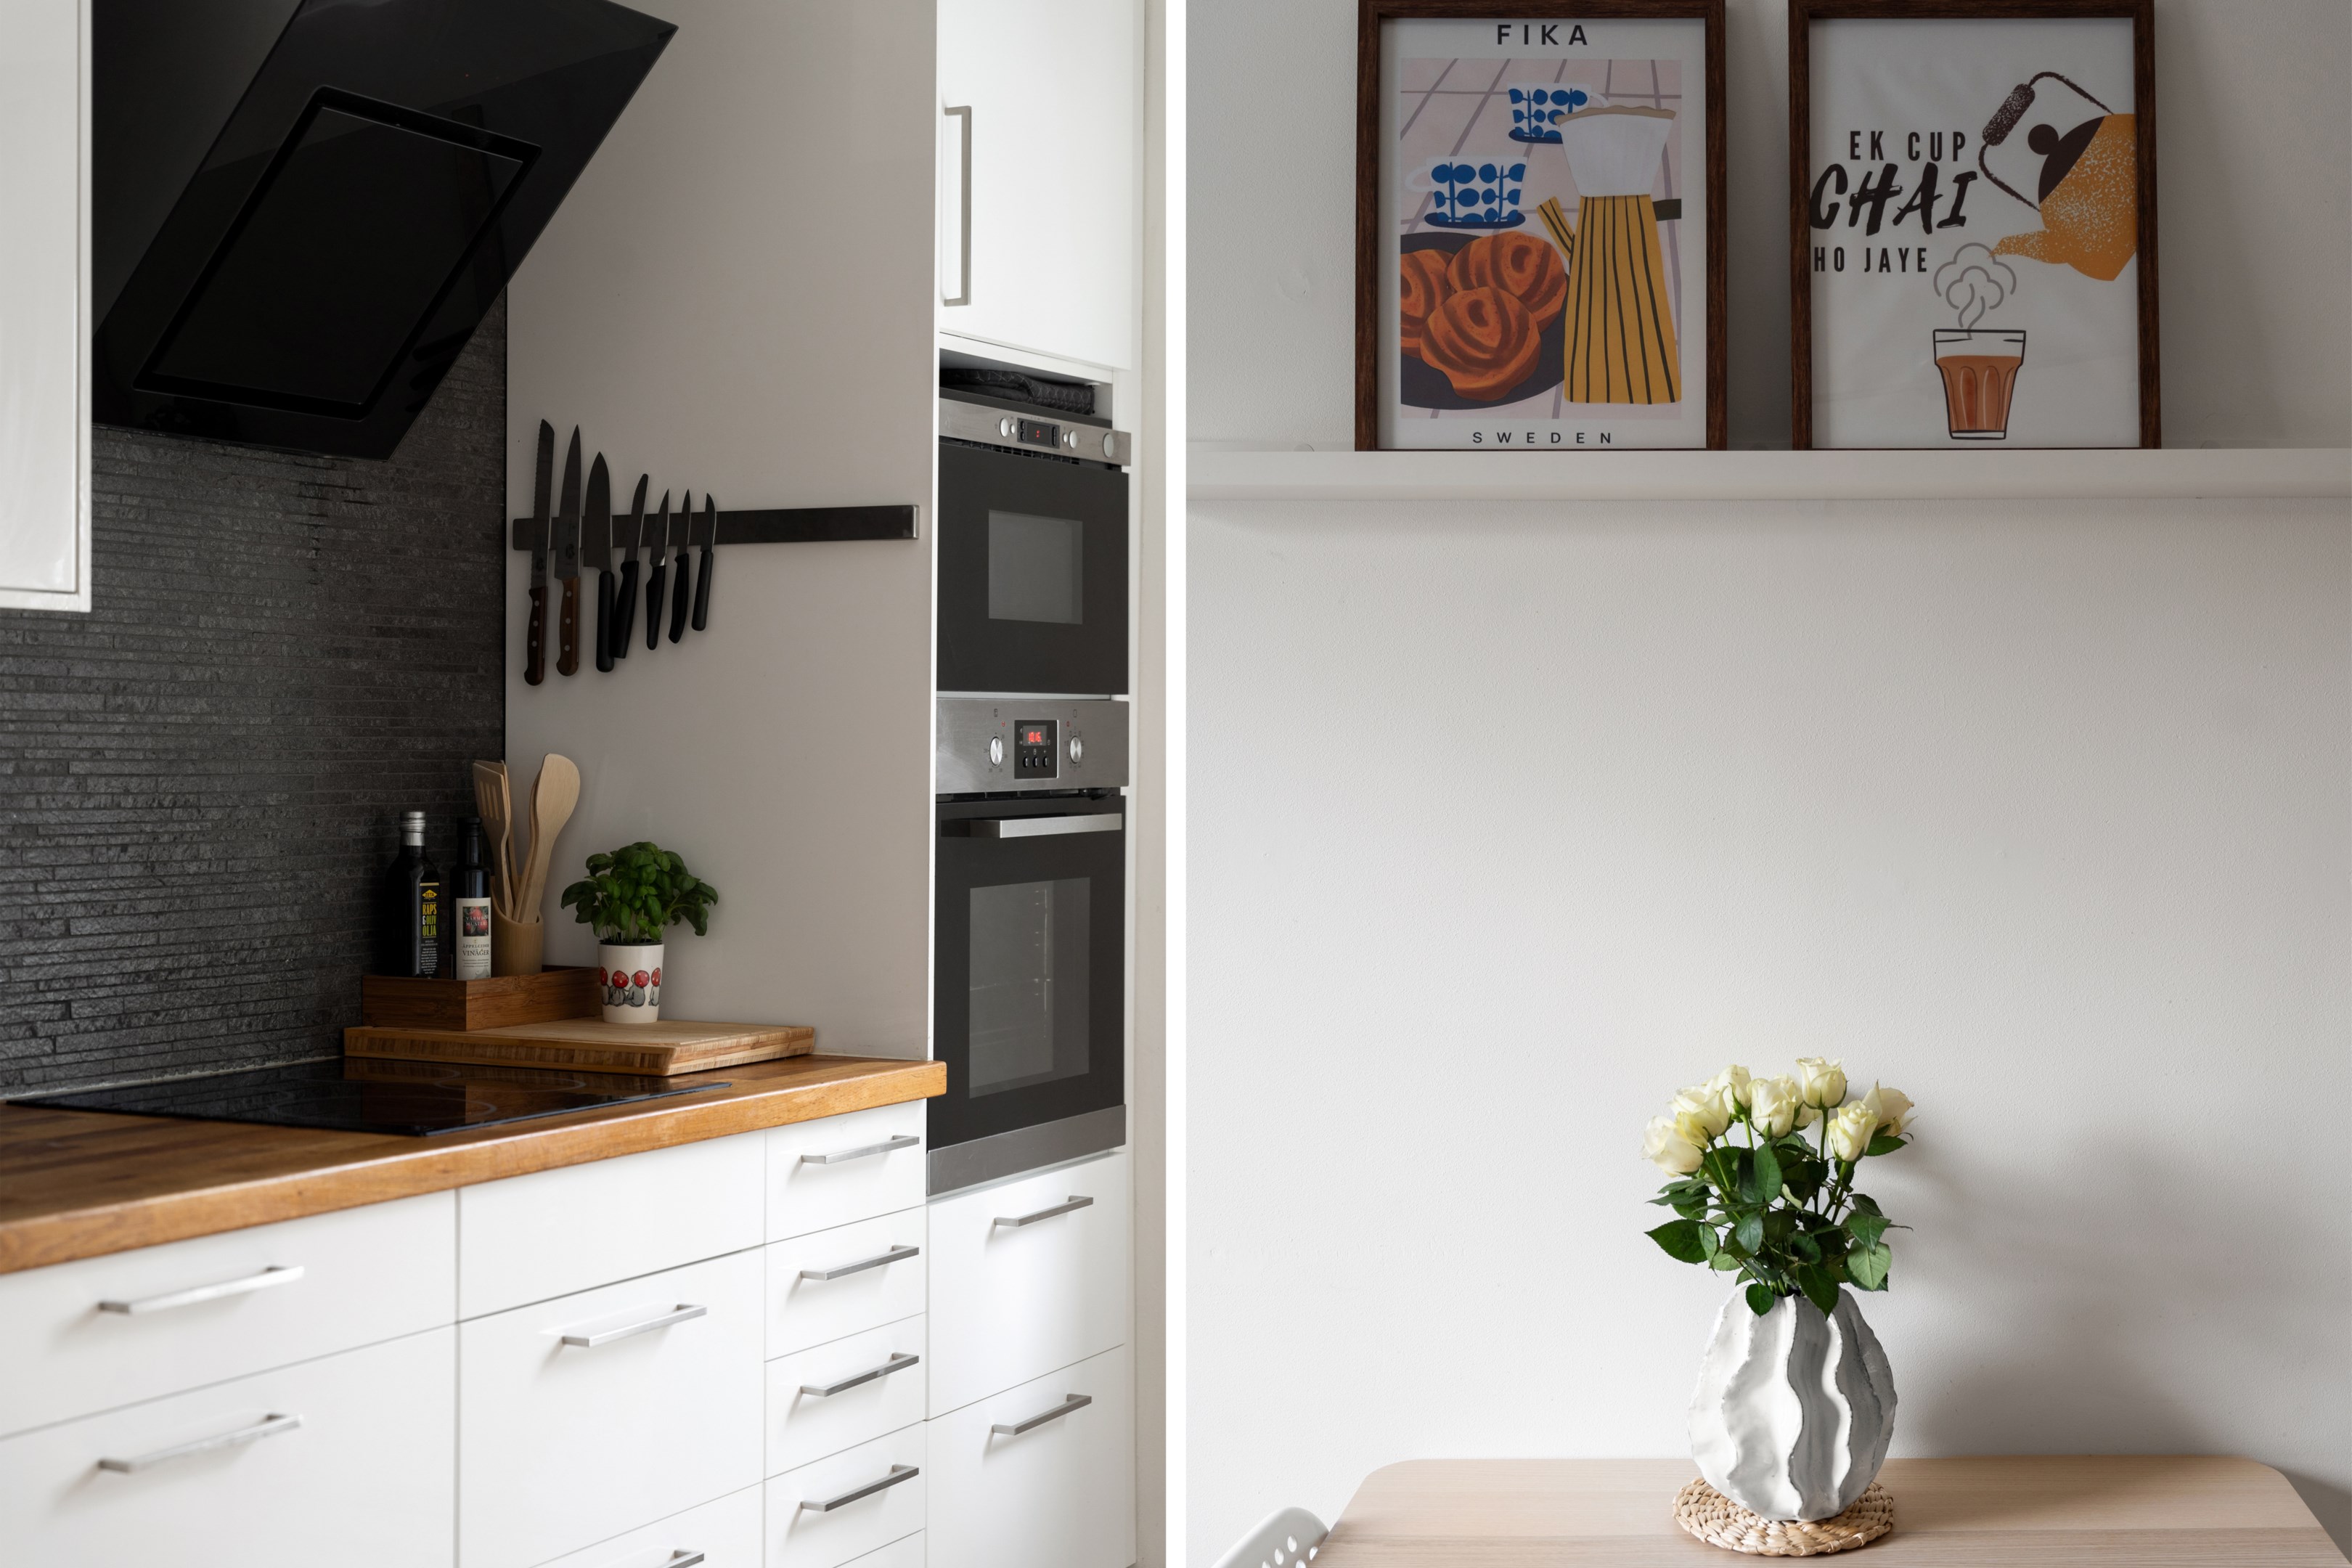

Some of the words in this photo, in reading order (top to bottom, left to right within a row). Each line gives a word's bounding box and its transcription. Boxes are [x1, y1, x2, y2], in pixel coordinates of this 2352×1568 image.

[1497, 23, 1588, 46] FIKA
[1850, 131, 1885, 160] EK
[1908, 131, 1966, 162] CUP
[1810, 162, 1978, 237] CHAI
[1813, 248, 1845, 272] HO
[1863, 248, 1927, 273] JAYE
[1472, 431, 1612, 444] SWEDEN
[422, 904, 437, 915] RAPS
[422, 915, 427, 925] &
[422, 925, 437, 936] OLJA
